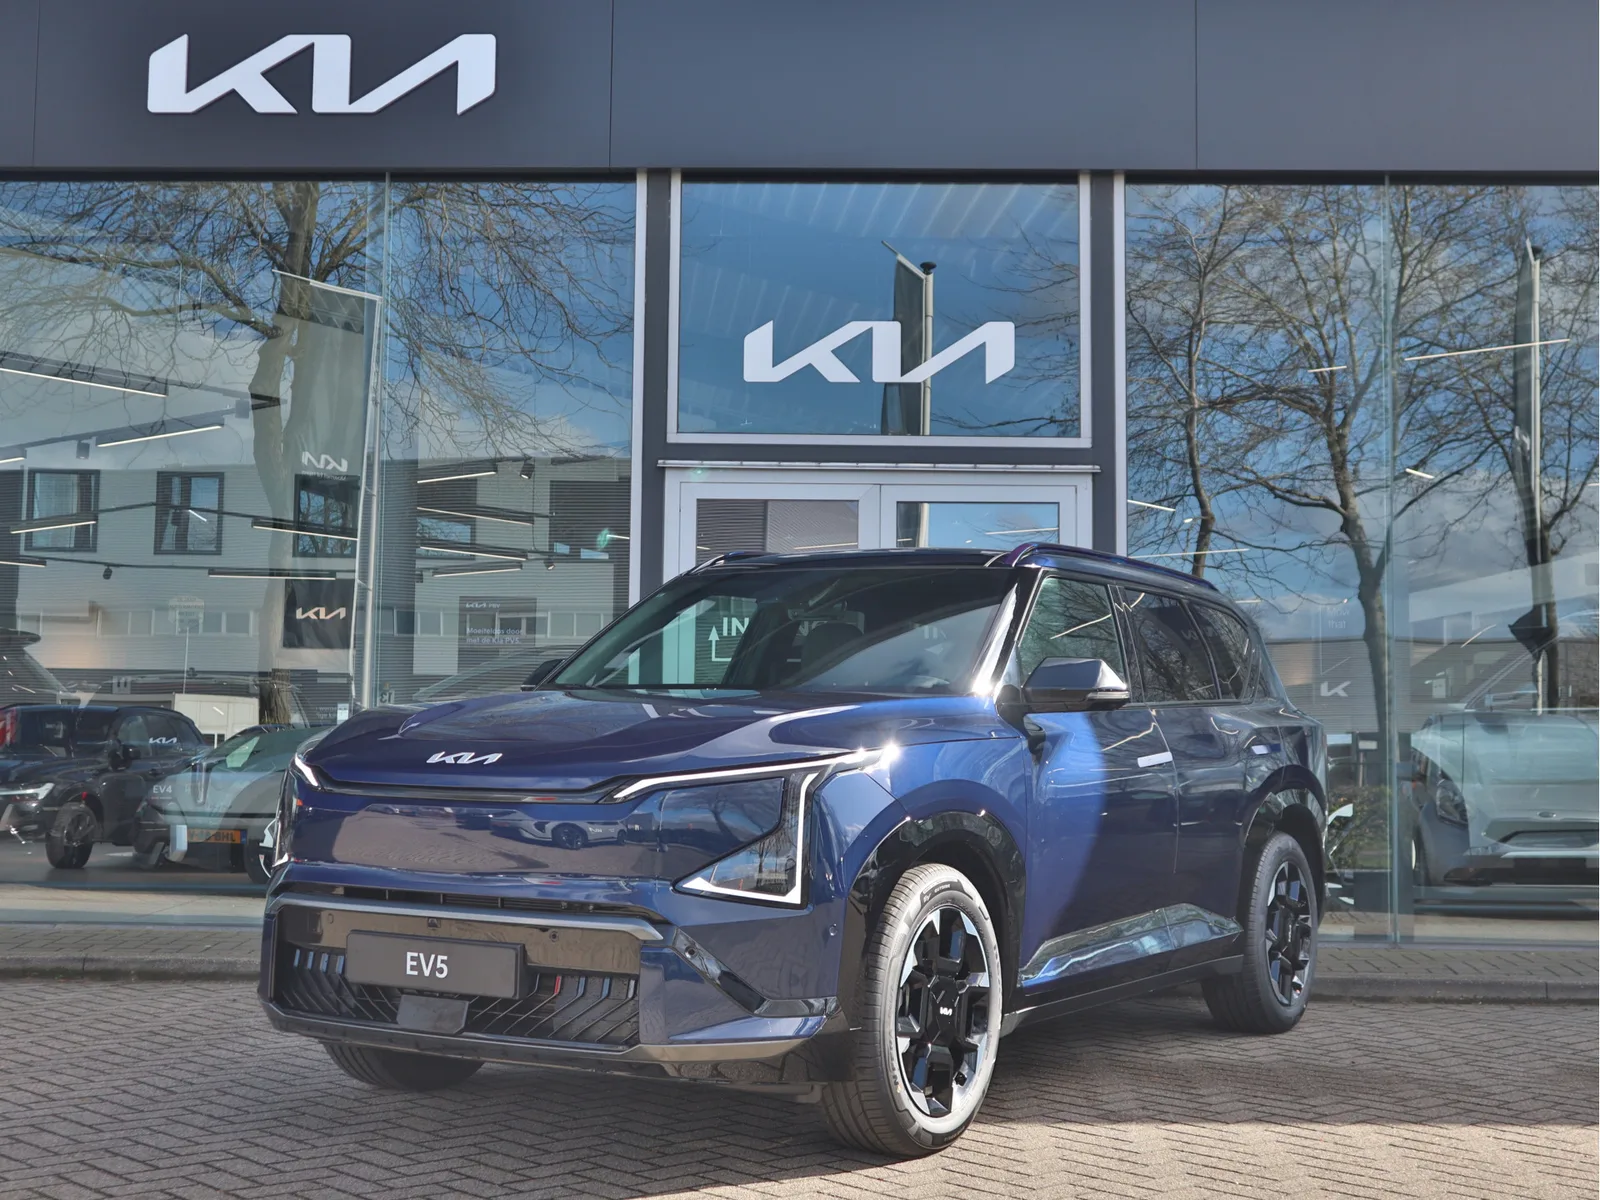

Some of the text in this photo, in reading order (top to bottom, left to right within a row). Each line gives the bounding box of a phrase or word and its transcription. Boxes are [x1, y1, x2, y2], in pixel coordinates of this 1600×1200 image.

[147, 33, 496, 116] KIA
[743, 320, 1015, 384] KIA
[296, 606, 347, 620] KIA
[426, 751, 503, 765] KIA
[152, 784, 173, 794] EV4
[406, 951, 448, 979] EV5
